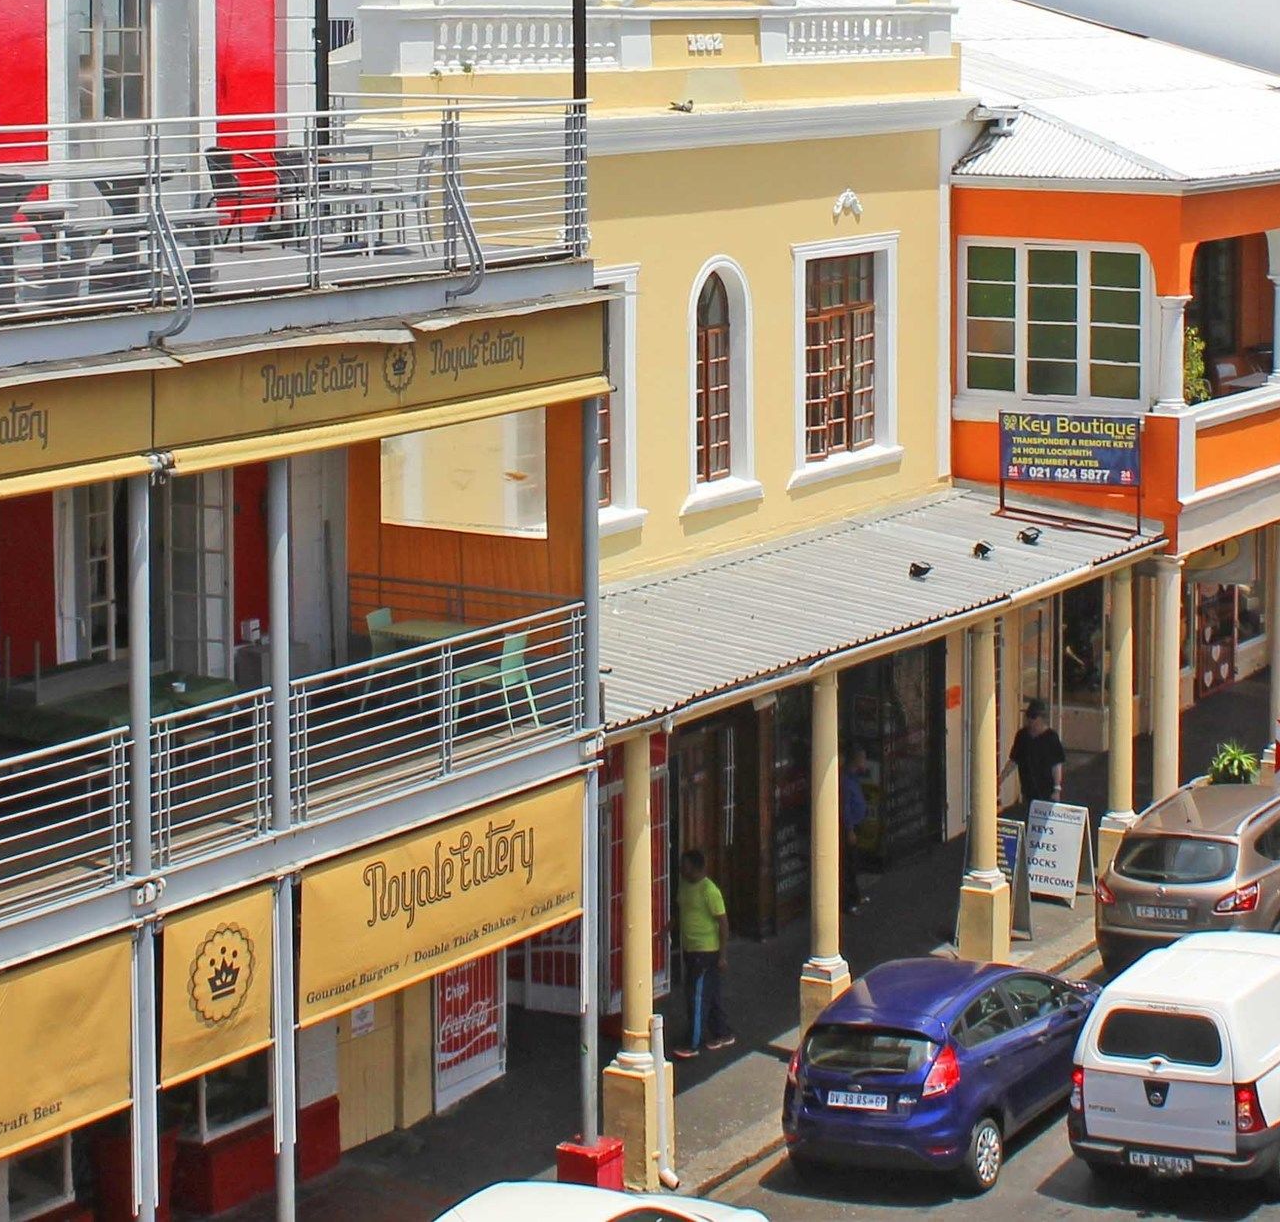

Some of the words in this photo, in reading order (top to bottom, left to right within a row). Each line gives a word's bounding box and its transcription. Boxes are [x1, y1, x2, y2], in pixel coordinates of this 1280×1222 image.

[430, 333, 479, 380] Royale
[476, 331, 525, 369] Eatery
[261, 358, 317, 409] Royale
[315, 352, 369, 398] Eatery
[1019, 416, 1051, 435] Key
[1056, 417, 1136, 437] Boutique
[1012, 437, 1070, 446] TRANSPONDER
[1079, 440, 1111, 448] REMOTE
[1047, 449, 1093, 457] LOCKSMITH
[1035, 458, 1068, 466] NUMBER
[1070, 459, 1099, 467] PLATES
[1029, 466, 1051, 478] 021
[1054, 468, 1077, 479] 424
[1080, 469, 1110, 480] 5877
[1031, 825, 1055, 836] KEYS
[1029, 840, 1057, 852] SAFES
[1027, 856, 1056, 869] LOCKS
[363, 840, 454, 931] Royale
[450, 819, 536, 892] Eatery
[1028, 873, 1074, 888] NTERCOMS
[306, 979, 357, 1005] Gourmet
[359, 960, 400, 989] Burgers
[413, 942, 450, 963] Double
[452, 928, 480, 948] Thick
[482, 915, 517, 936] Shakes
[530, 899, 555, 917] Craft
[556, 890, 576, 906] Beer
[445, 982, 469, 1002] Chips
[33, 1100, 62, 1120] Beer
